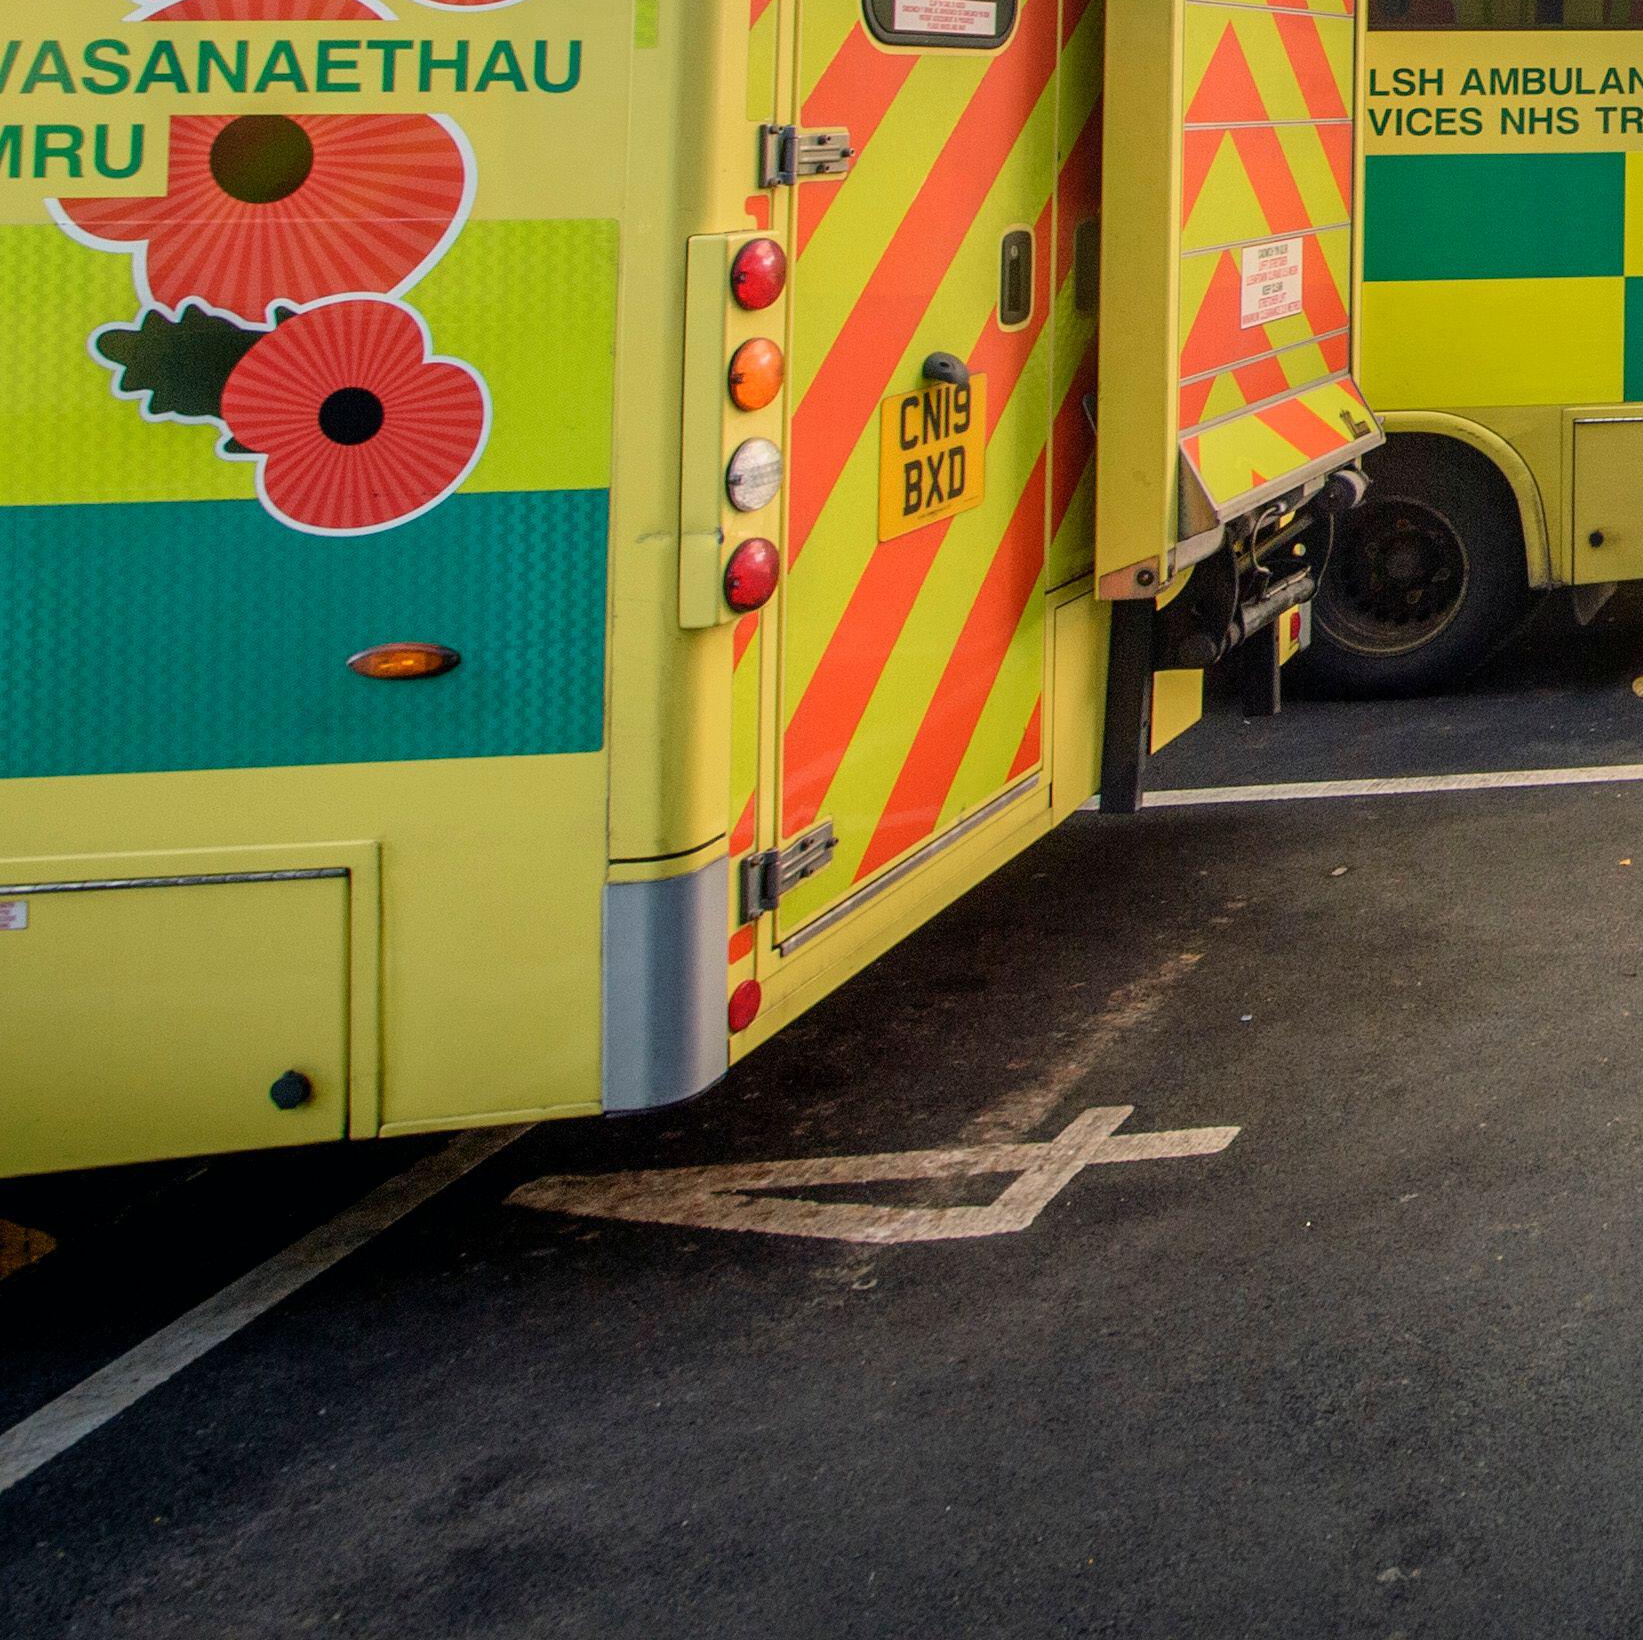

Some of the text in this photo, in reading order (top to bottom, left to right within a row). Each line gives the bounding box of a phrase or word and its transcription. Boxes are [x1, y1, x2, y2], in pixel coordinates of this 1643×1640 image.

[1500, 107, 1579, 135] NHS
[900, 385, 971, 451] CN19
[903, 445, 966, 517] BXD
